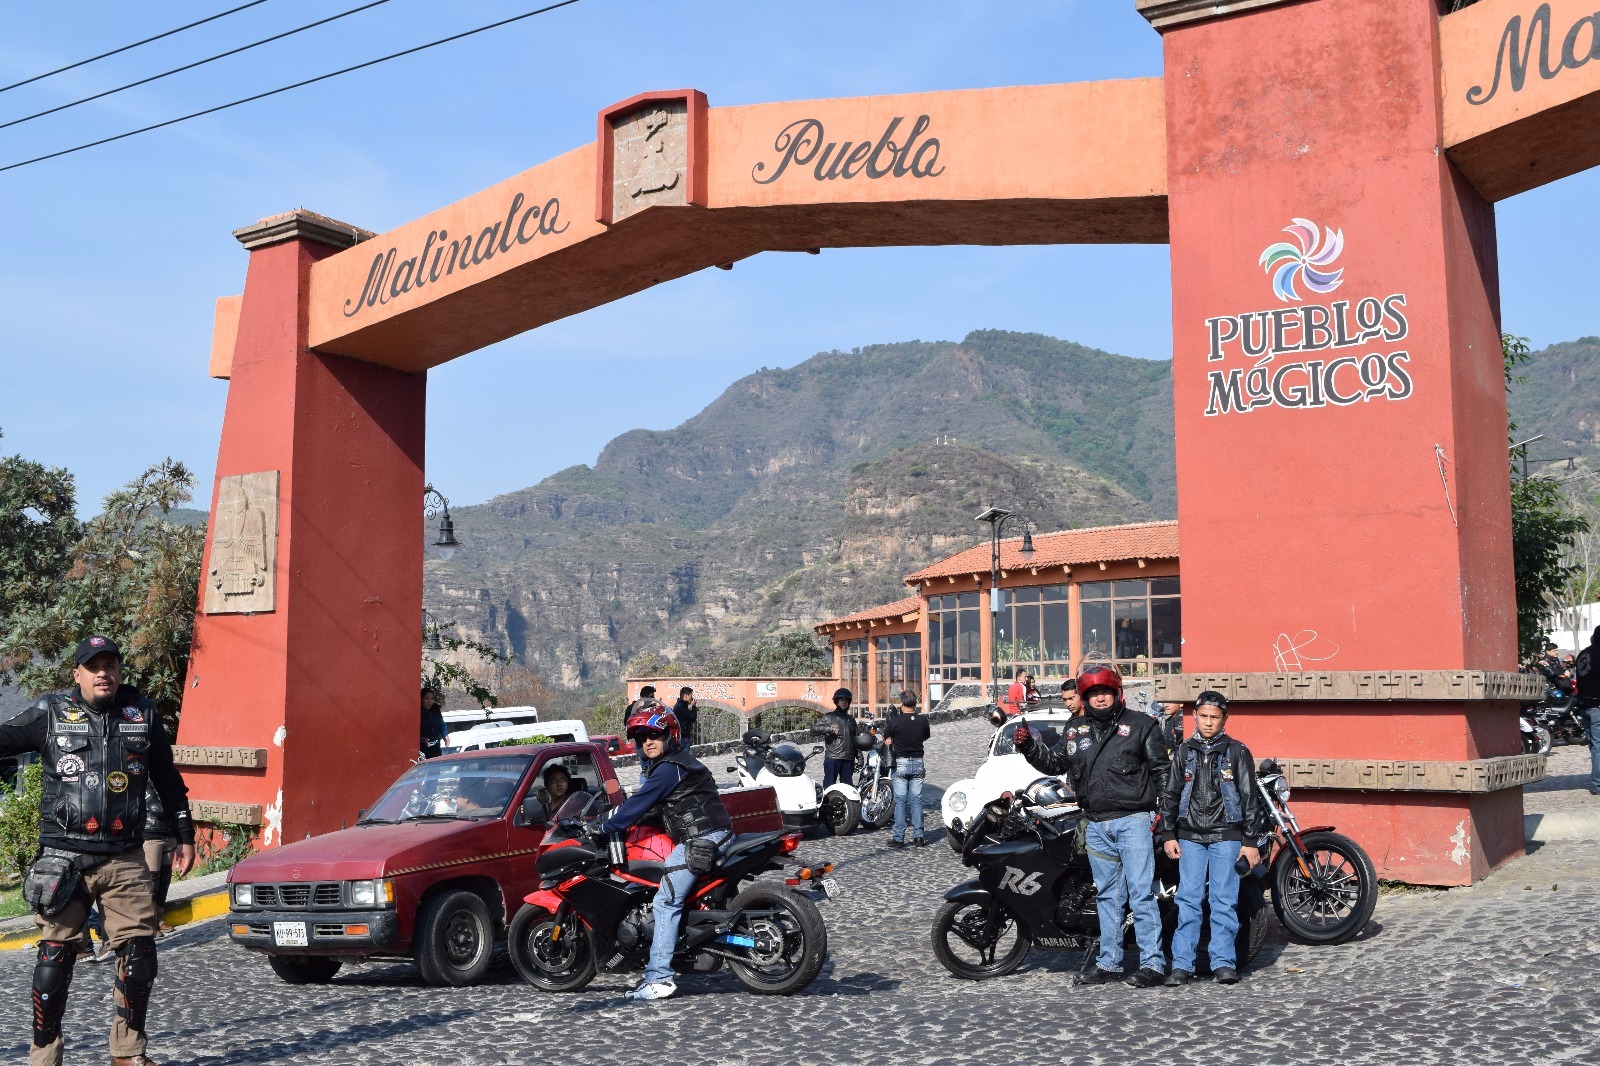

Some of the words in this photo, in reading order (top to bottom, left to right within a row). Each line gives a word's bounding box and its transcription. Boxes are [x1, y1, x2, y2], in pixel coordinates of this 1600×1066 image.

[343, 192, 570, 318] Malinalco
[1205, 293, 1410, 362] PUEBLOS
[997, 865, 1045, 896] R6
[1036, 936, 1080, 948] YAMAHA
[605, 952, 625, 969] YAMAHA
